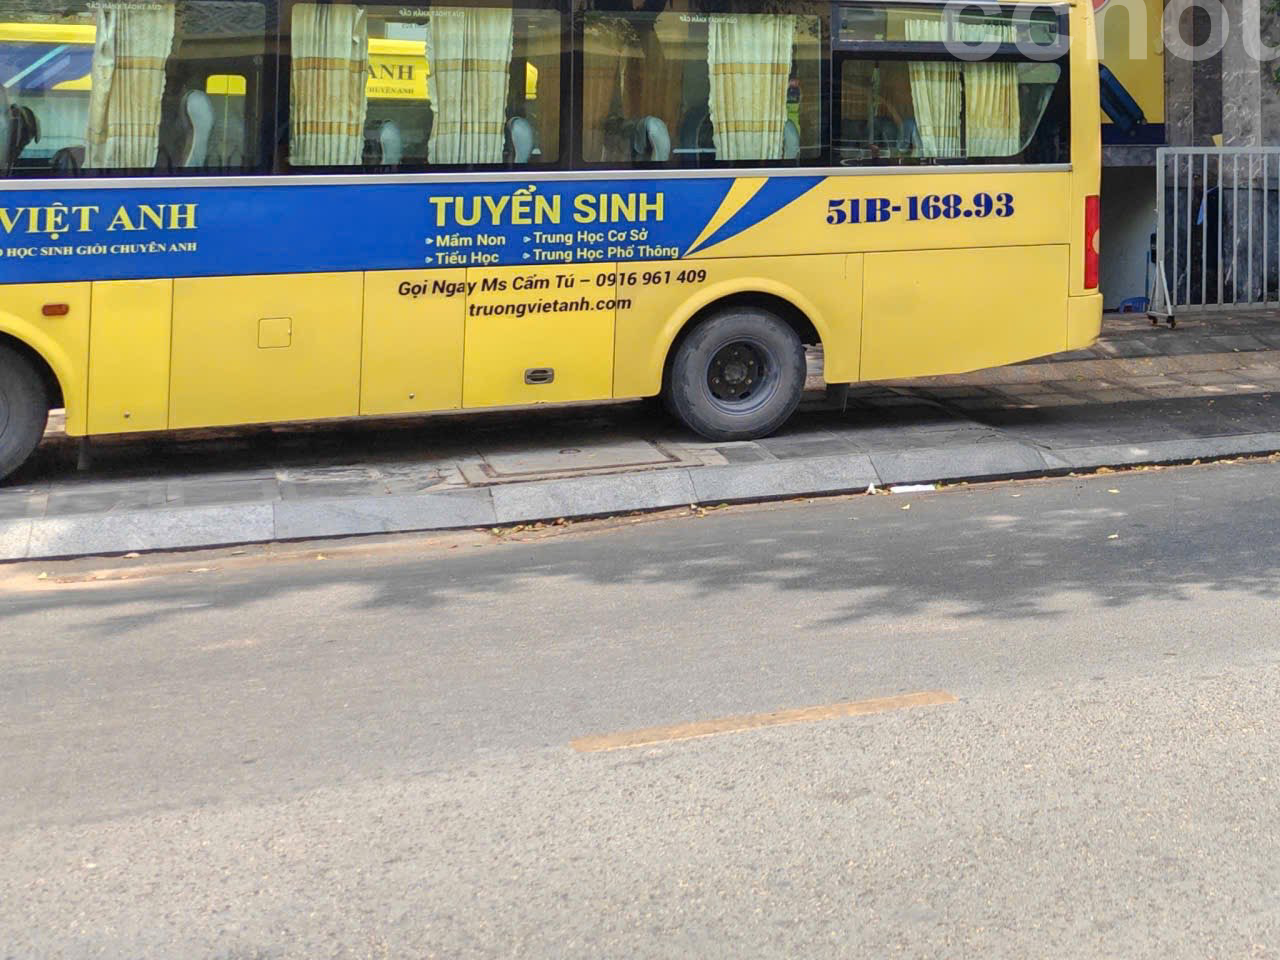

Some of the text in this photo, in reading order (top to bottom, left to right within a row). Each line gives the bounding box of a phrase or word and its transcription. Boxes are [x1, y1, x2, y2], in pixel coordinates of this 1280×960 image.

[429, 184, 665, 227] TUYỂN SINH
[826, 192, 1015, 226] 51B-168.93
[0, 202, 199, 240] VIỆT ANH
[436, 233, 506, 247] Mầm Non
[533, 226, 648, 246] Trung Học Cơ Sở
[7, 241, 197, 259] HỌC SINH GIỎI CHUYÊN ANH
[436, 250, 499, 267] Tiểu Học
[533, 243, 679, 264] Trung Học Phổ Thông
[398, 269, 708, 300] Gọi Ngay Ms Cẩm Tú 0916 961 409
[469, 297, 632, 318] truongvietanh.com
